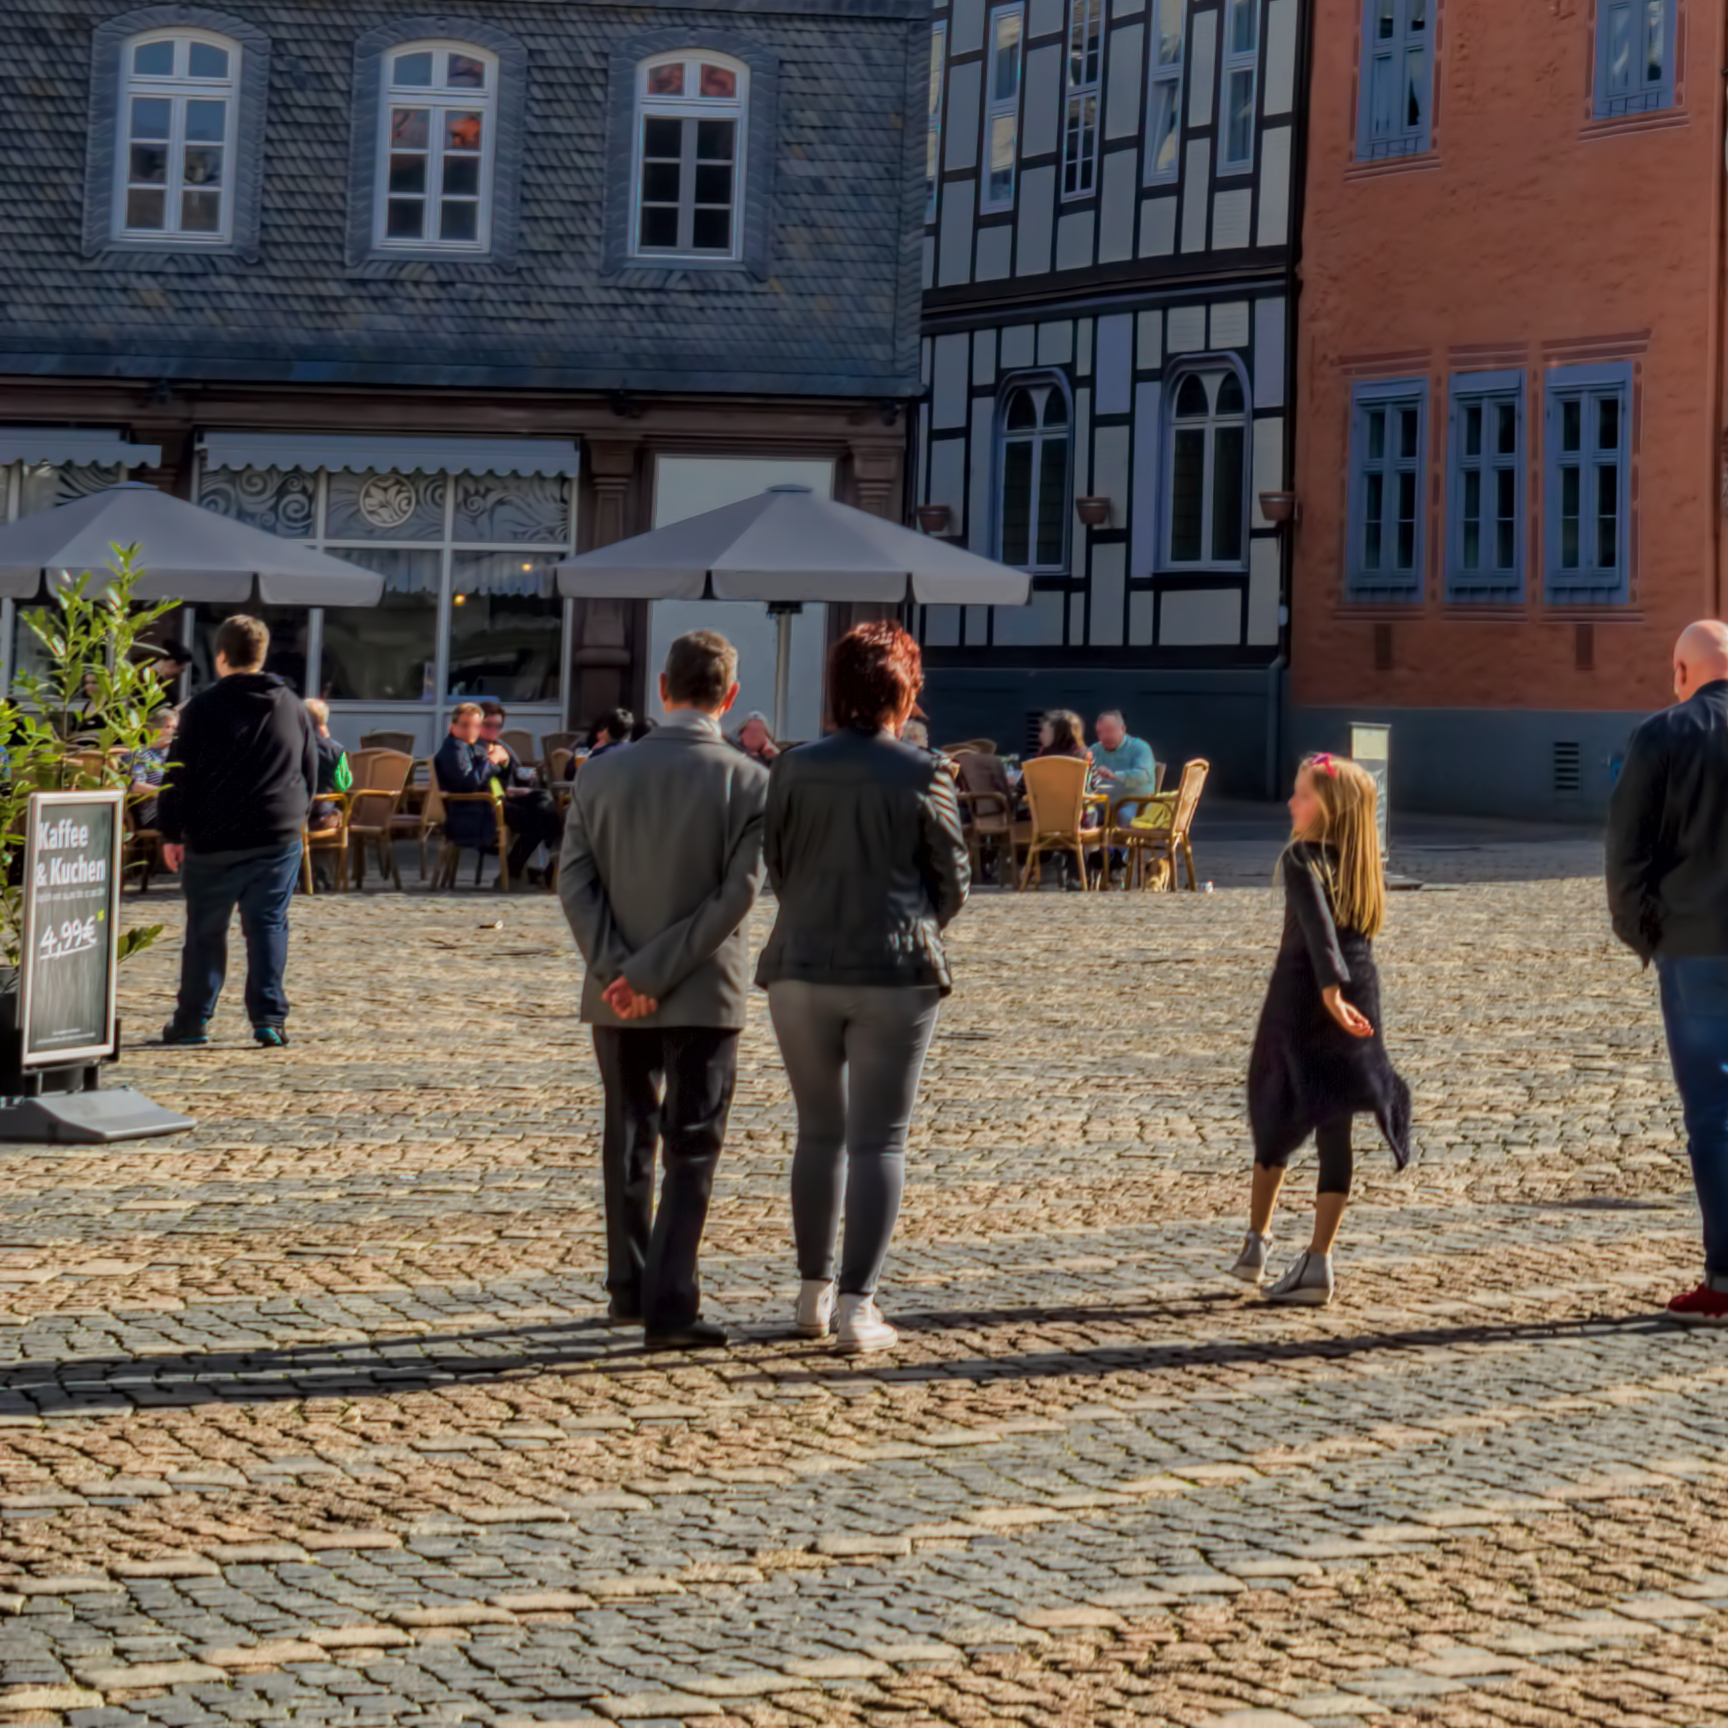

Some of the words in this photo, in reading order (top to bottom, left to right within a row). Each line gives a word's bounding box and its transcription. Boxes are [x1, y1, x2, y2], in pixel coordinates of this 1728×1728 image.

[38, 818, 89, 850] Kaffee
[36, 861, 47, 887] &
[50, 854, 106, 886] Kuchen
[39, 915, 98, 955] 4,99€
